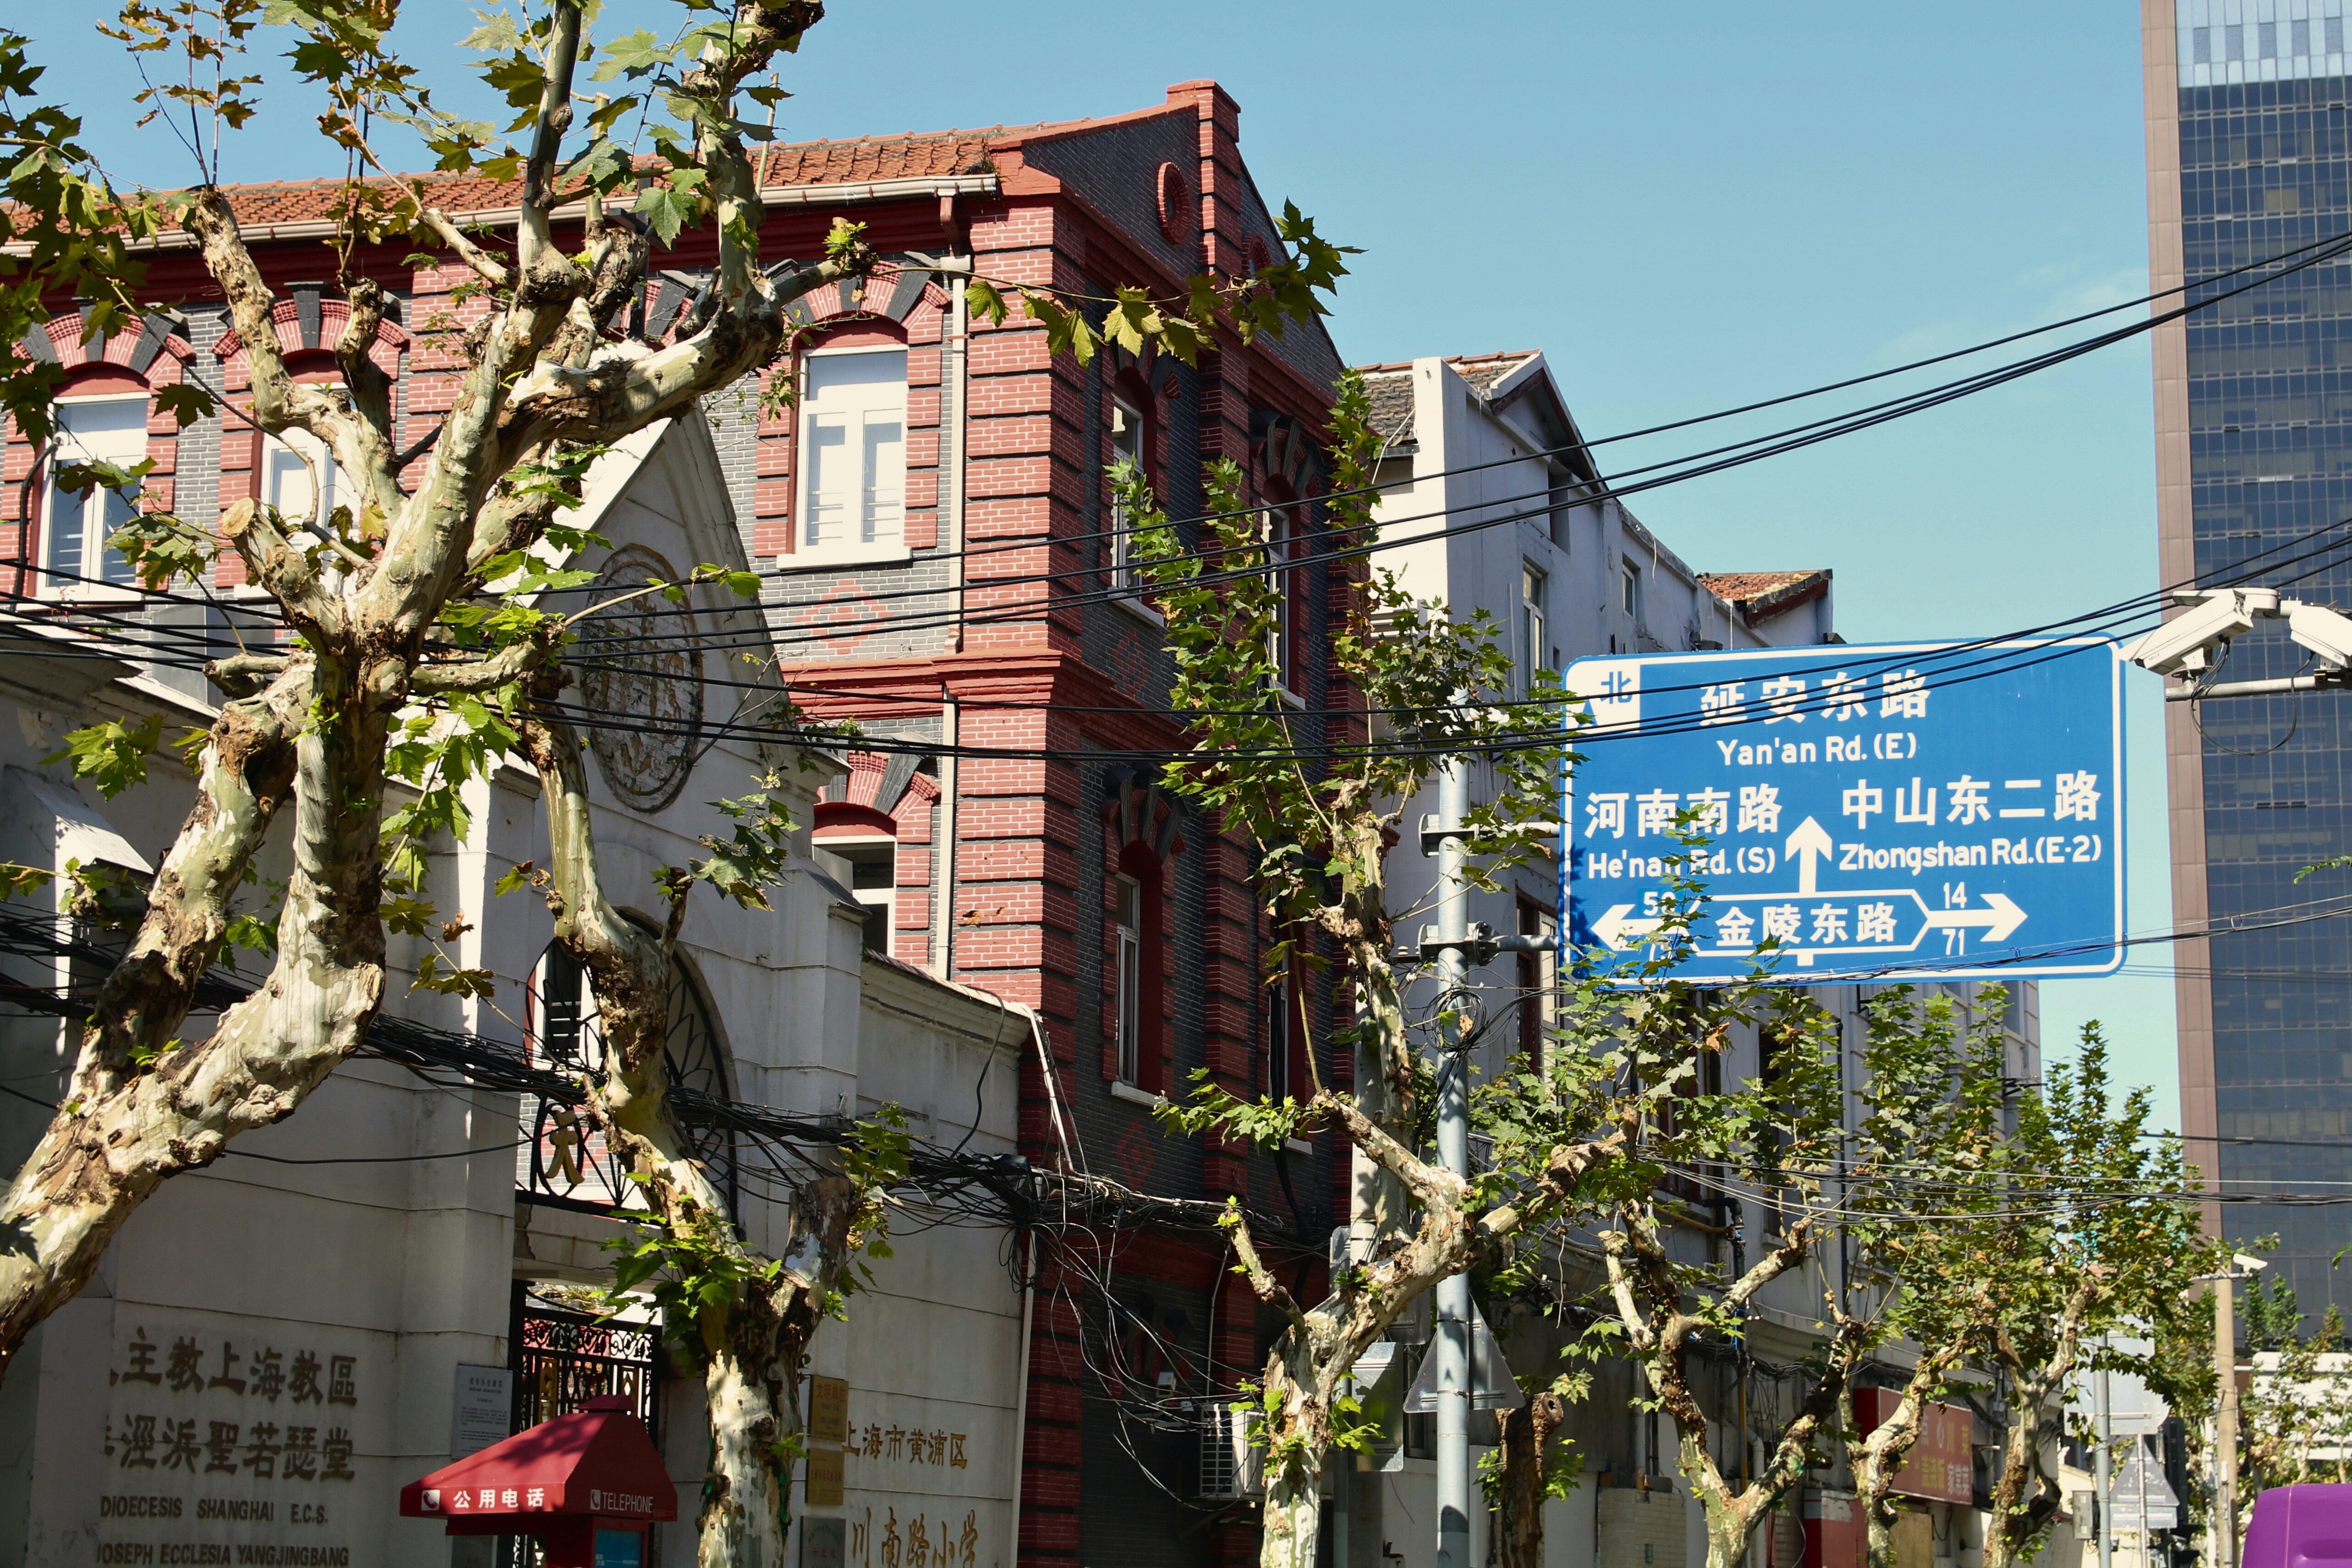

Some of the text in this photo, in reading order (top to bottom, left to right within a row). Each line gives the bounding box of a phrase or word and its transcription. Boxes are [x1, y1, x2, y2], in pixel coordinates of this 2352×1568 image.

[1600, 671, 1633, 704] 北
[1699, 669, 1931, 726] 延安东路
[1717, 732, 1917, 765] Yan'an Rd. (E)
[1584, 783, 1782, 839] 河南南路
[1842, 770, 2101, 830] 中山东二路
[1690, 848, 1732, 875] Rd.
[1736, 847, 1775, 874] (S)
[1839, 839, 1986, 876] Zhongshan
[1943, 881, 1967, 909] 14
[1715, 903, 1897, 947] 金陵东路
[1942, 928, 1965, 956] 71
[110, 1325, 357, 1407] 主教上海教區
[105, 1413, 355, 1481] 涇浜聖若瑟堂
[842, 1420, 968, 1469] 上海市黄浦区
[100, 1495, 183, 1518] DIOECESIS
[197, 1498, 274, 1523] SHANGHAI
[453, 1488, 545, 1509] 公用电话
[602, 1492, 654, 1513] TELEPHONE
[160, 1544, 231, 1566] ECCLESIA
